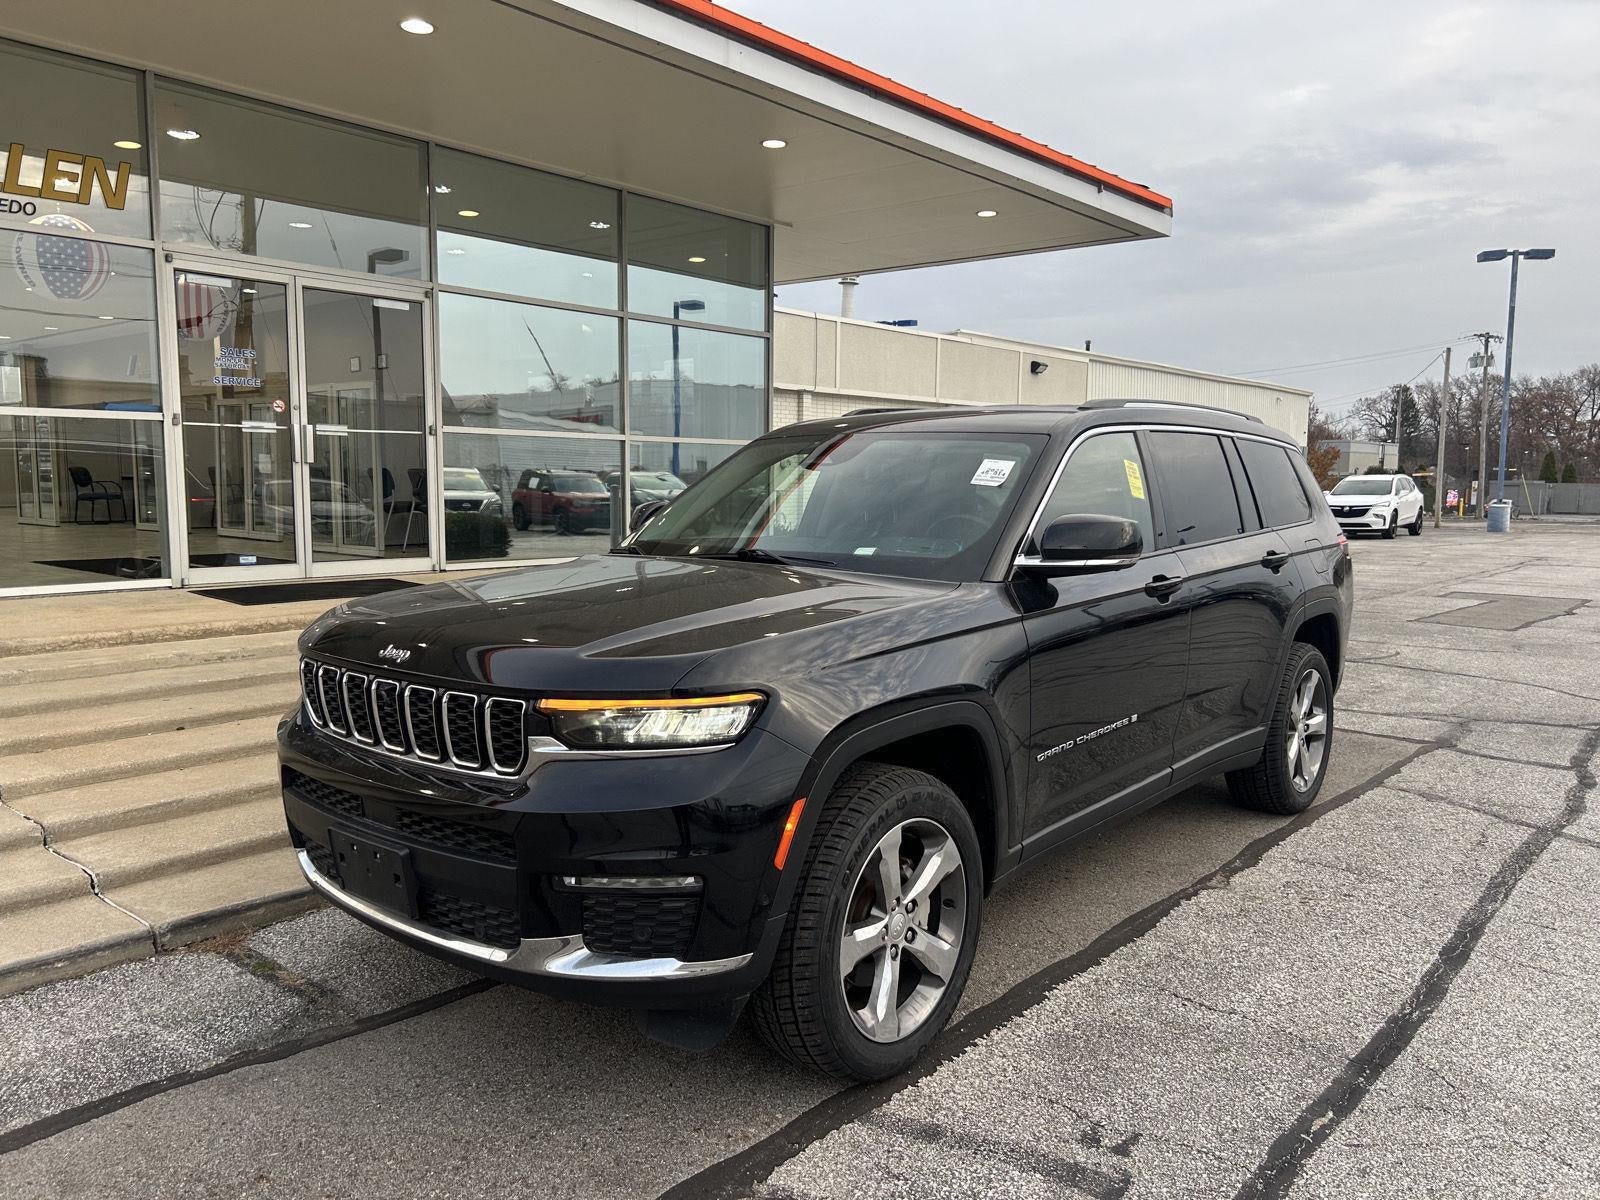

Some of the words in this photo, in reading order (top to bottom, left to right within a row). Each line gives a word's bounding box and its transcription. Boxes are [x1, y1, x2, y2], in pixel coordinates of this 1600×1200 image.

[0, 142, 131, 210] LEN
[220, 347, 256, 358] SALES
[214, 376, 261, 387] SERVICE
[379, 644, 411, 663] Jeep
[1037, 740, 1075, 762] GRAND
[1076, 718, 1130, 745] CHEROKEE
[841, 807, 896, 889] GENERAL
